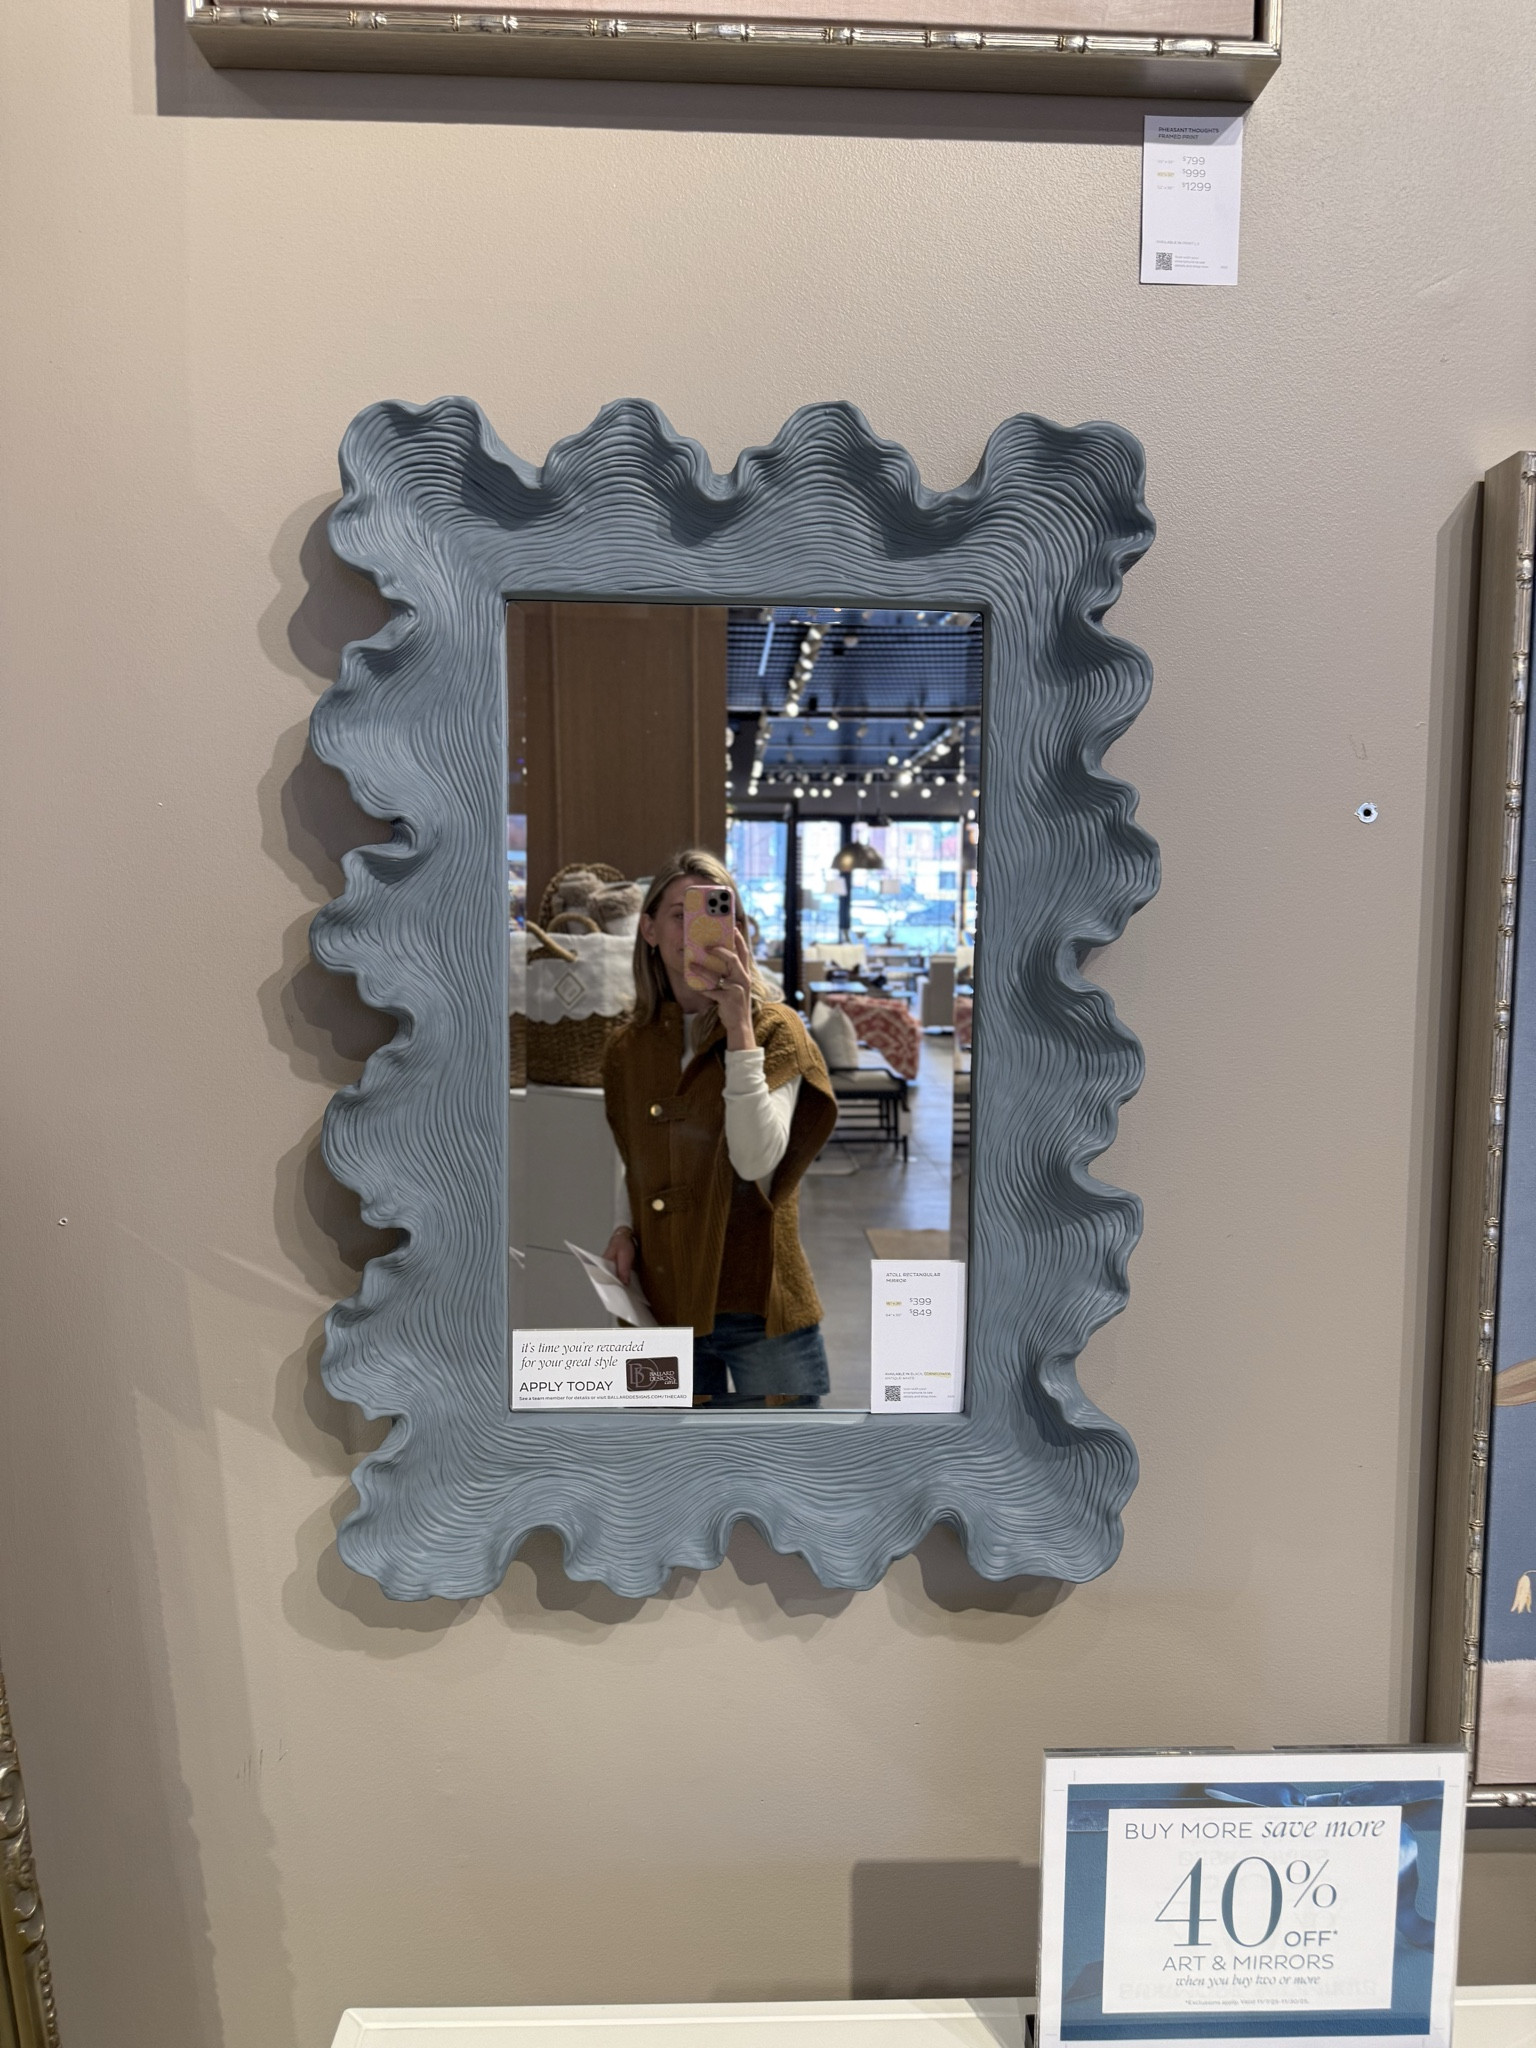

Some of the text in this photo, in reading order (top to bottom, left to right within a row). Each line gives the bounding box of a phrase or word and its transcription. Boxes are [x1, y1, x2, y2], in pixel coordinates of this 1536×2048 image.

[1182, 155, 1205, 166] $799
[1182, 168, 1206, 178] $999
[1182, 181, 1212, 192] $1299
[909, 1297, 932, 1306] $399
[909, 1309, 932, 1317] $849
[521, 1341, 645, 1355] it's time you're rewarded
[520, 1356, 619, 1370] for your great style
[519, 1380, 614, 1392] APPLY TODAY
[1125, 1819, 1385, 1839] BUY MORE save more
[1155, 1856, 1337, 1948] 40%
[1162, 1953, 1334, 1972] ART & MIRRORS
[1175, 1974, 1320, 1989] when you buy two or more
